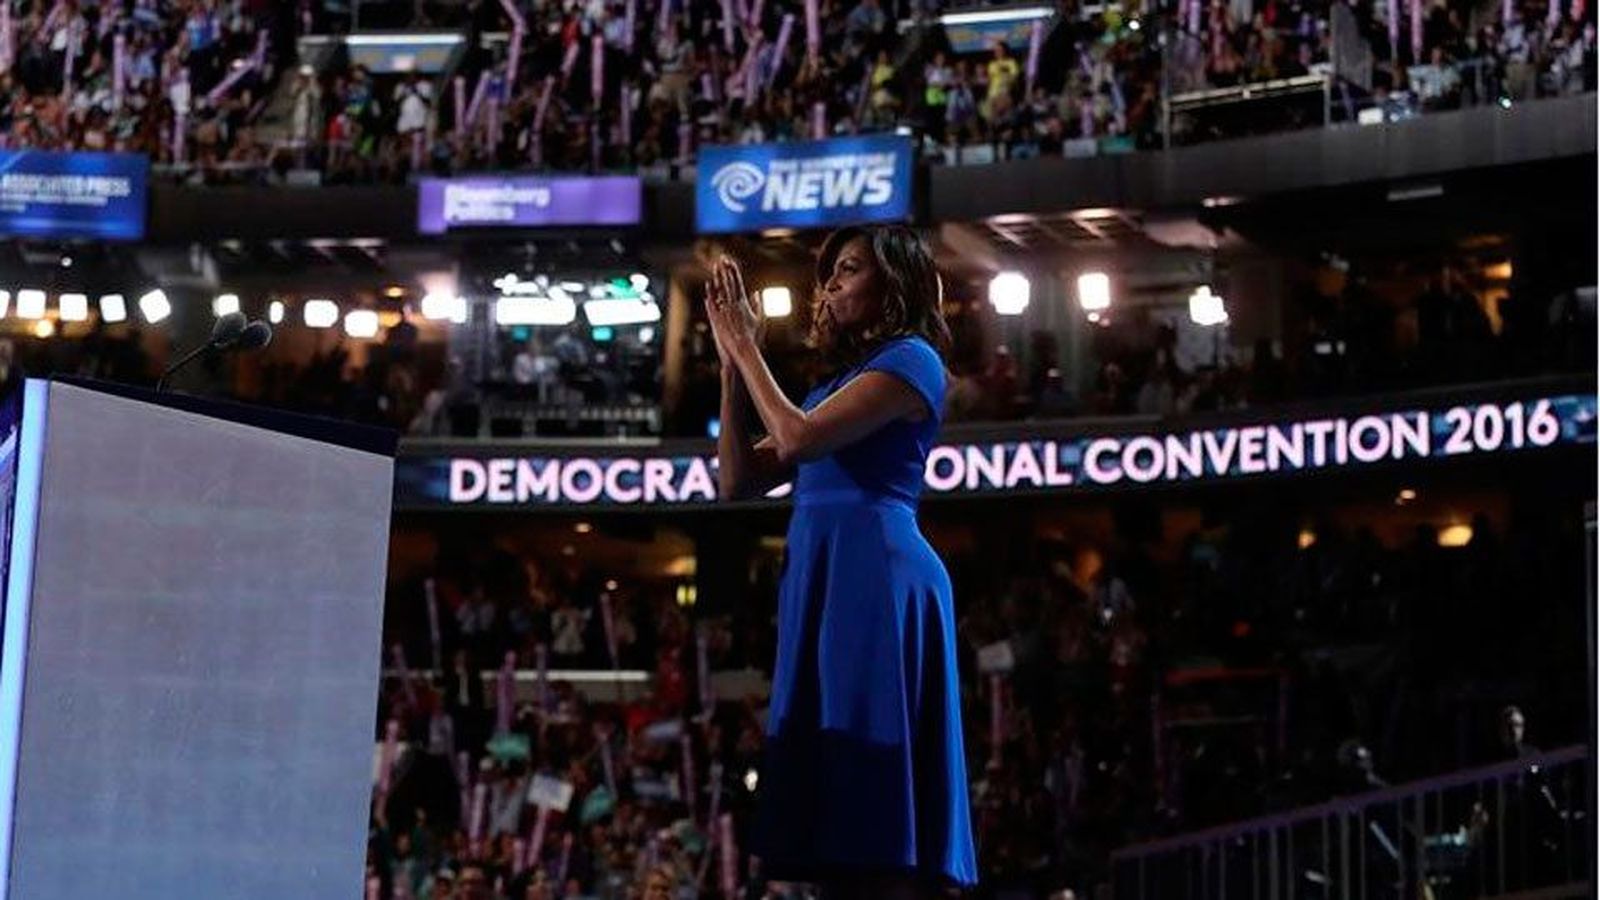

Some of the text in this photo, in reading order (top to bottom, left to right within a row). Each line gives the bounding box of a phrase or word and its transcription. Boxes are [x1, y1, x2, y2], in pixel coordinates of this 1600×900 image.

[87, 176, 131, 198] PRESS
[761, 166, 895, 212] NEWS
[1083, 410, 1430, 484] CONVENTION
[1444, 398, 1560, 455] 2016
